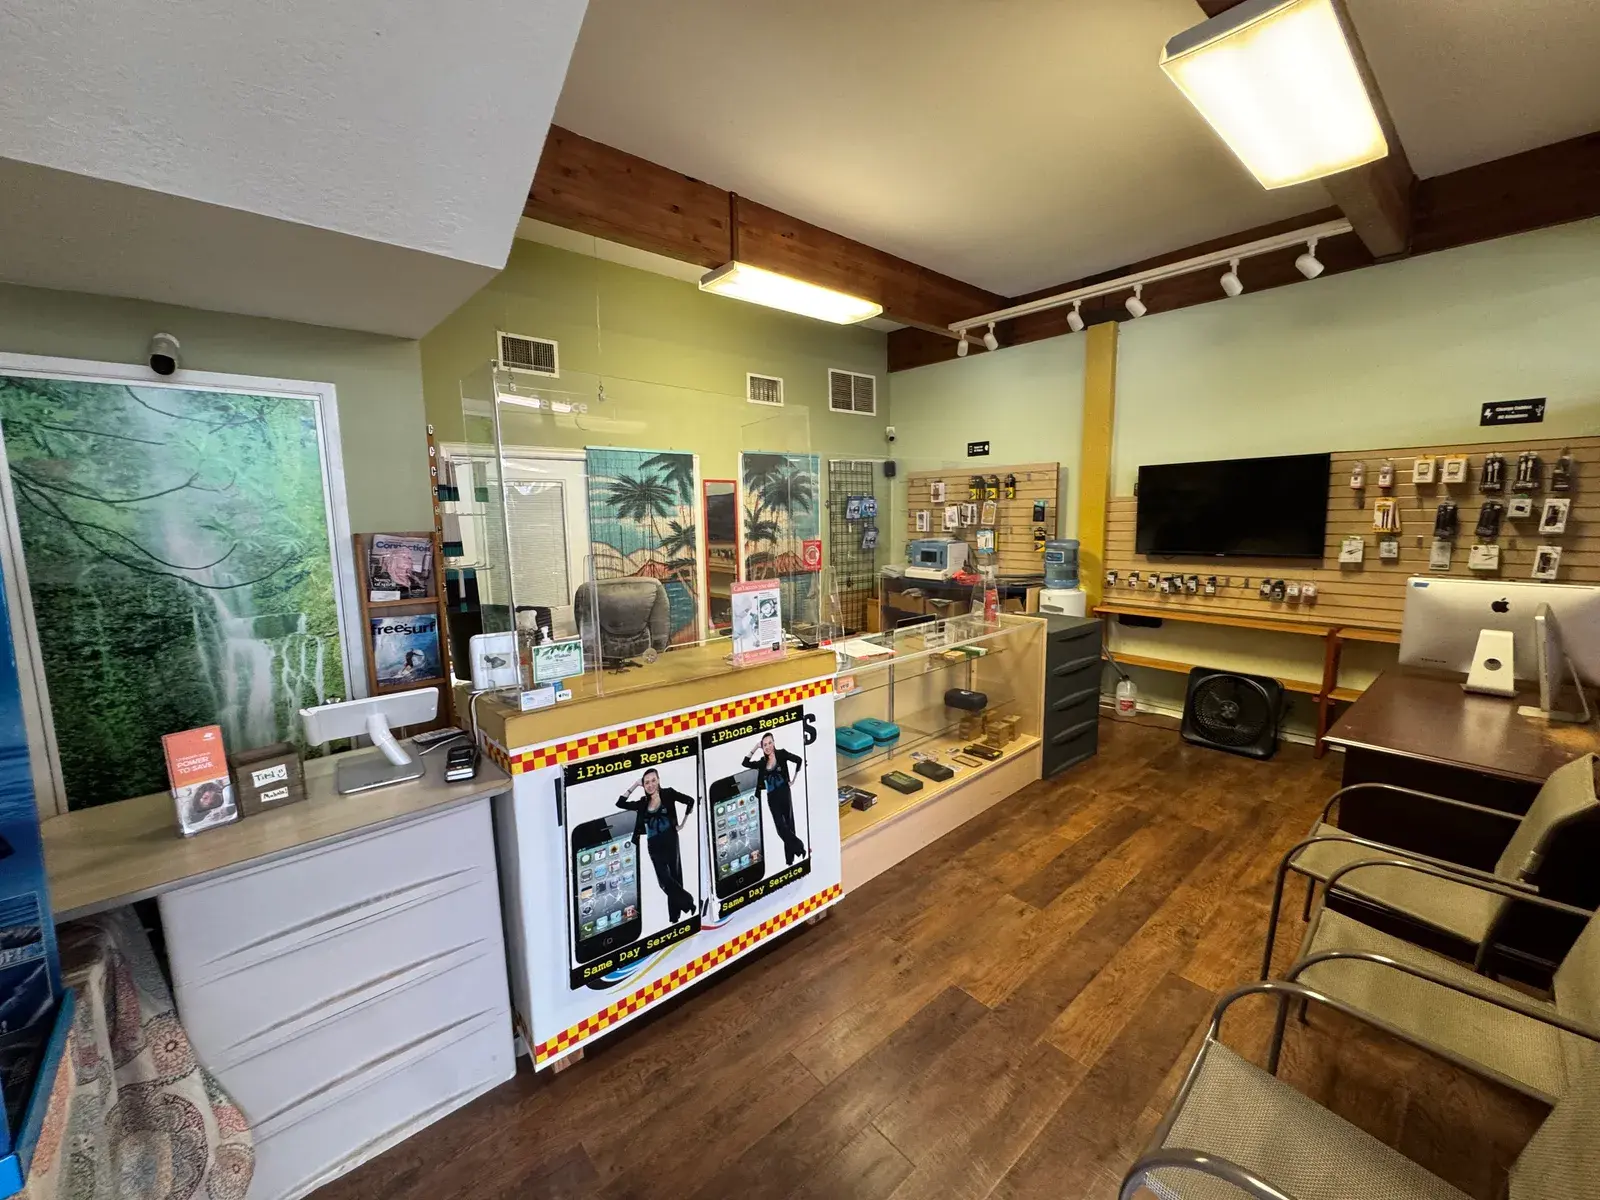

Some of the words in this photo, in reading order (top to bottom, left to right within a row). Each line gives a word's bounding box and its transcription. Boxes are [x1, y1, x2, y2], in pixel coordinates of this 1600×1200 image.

[530, 394, 588, 414] eice
[711, 725, 753, 743] iPhone
[759, 711, 797, 729] Repair
[176, 756, 210, 769] POWER
[576, 759, 632, 780] iPhone
[640, 745, 690, 765] Repair
[722, 895, 745, 912] Same
[748, 885, 765, 899] Day
[769, 866, 803, 888] Service
[583, 959, 613, 978] Same
[619, 946, 641, 962] Day
[646, 924, 691, 949] Service
